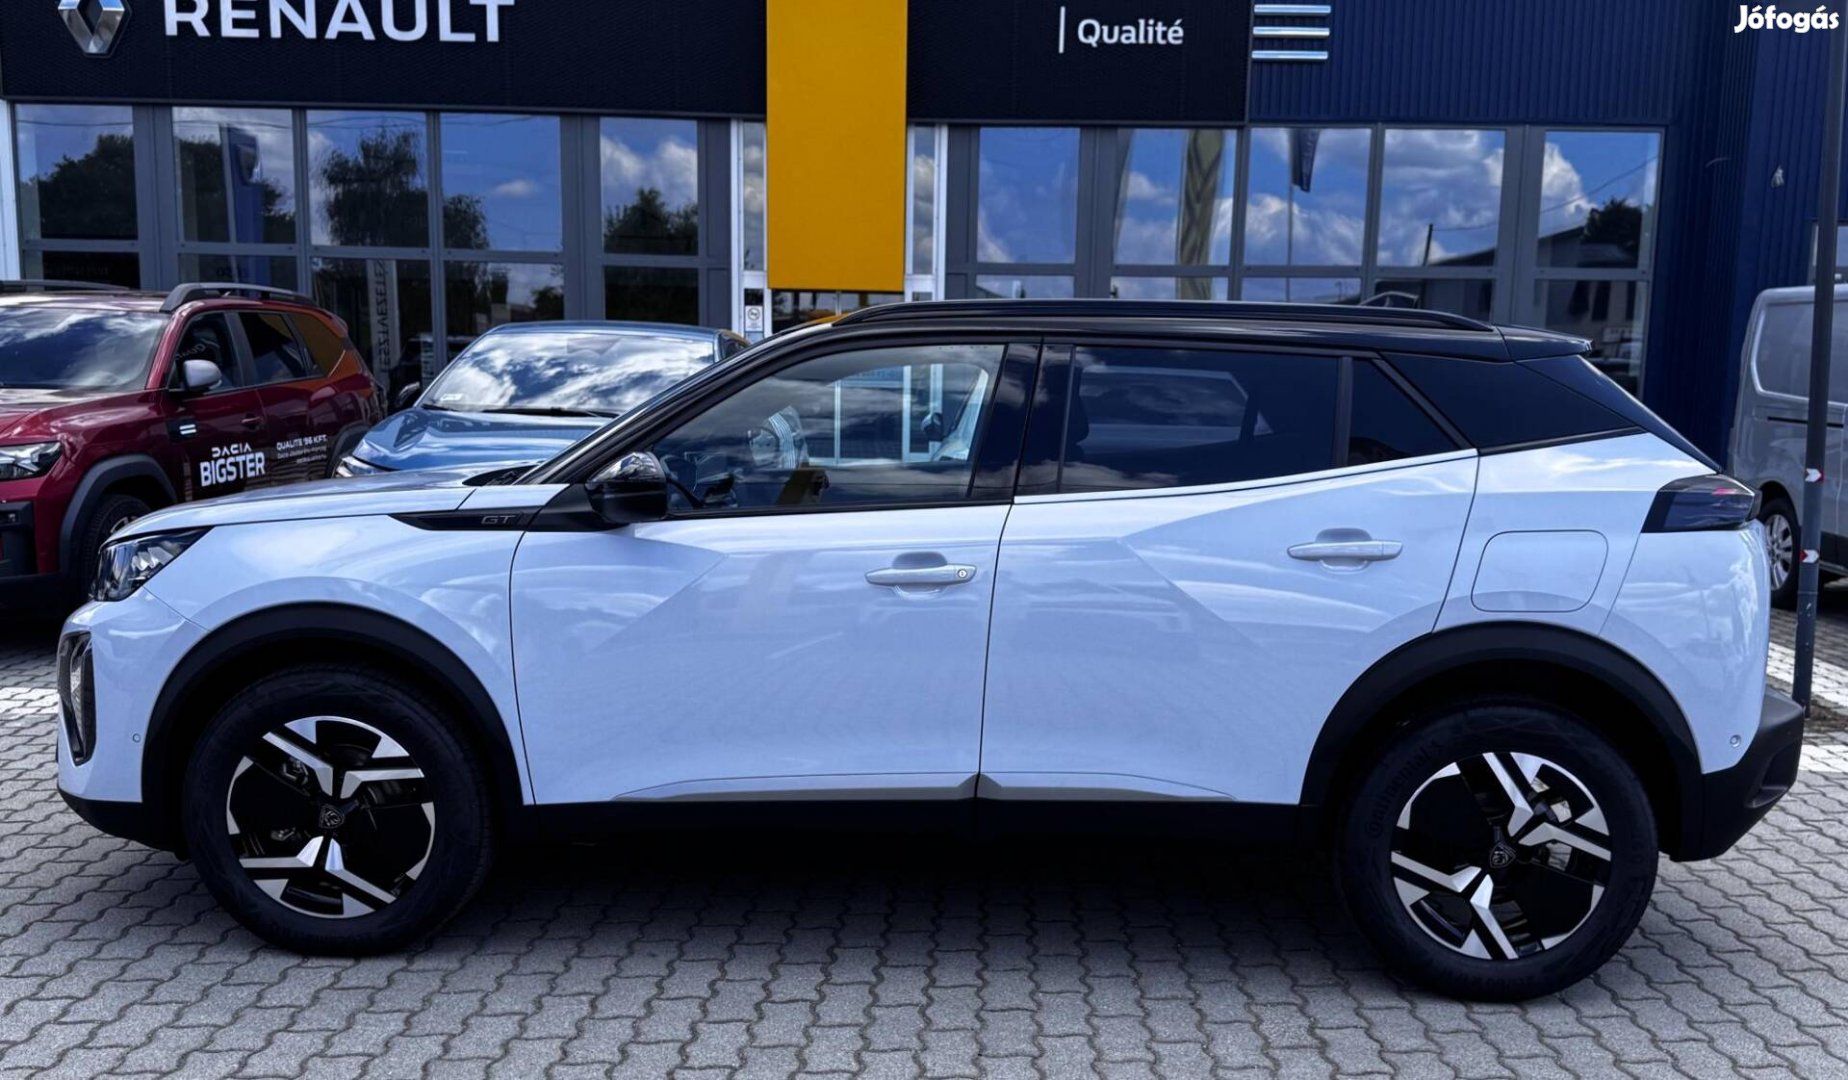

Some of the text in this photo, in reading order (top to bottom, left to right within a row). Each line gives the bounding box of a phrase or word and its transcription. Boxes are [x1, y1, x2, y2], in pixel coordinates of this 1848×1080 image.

[164, 0, 515, 42] RENAULT
[1078, 19, 1184, 48] Qualité
[211, 442, 252, 458] DACIA
[199, 451, 266, 487] BIGSTER
[480, 514, 516, 525] GT
